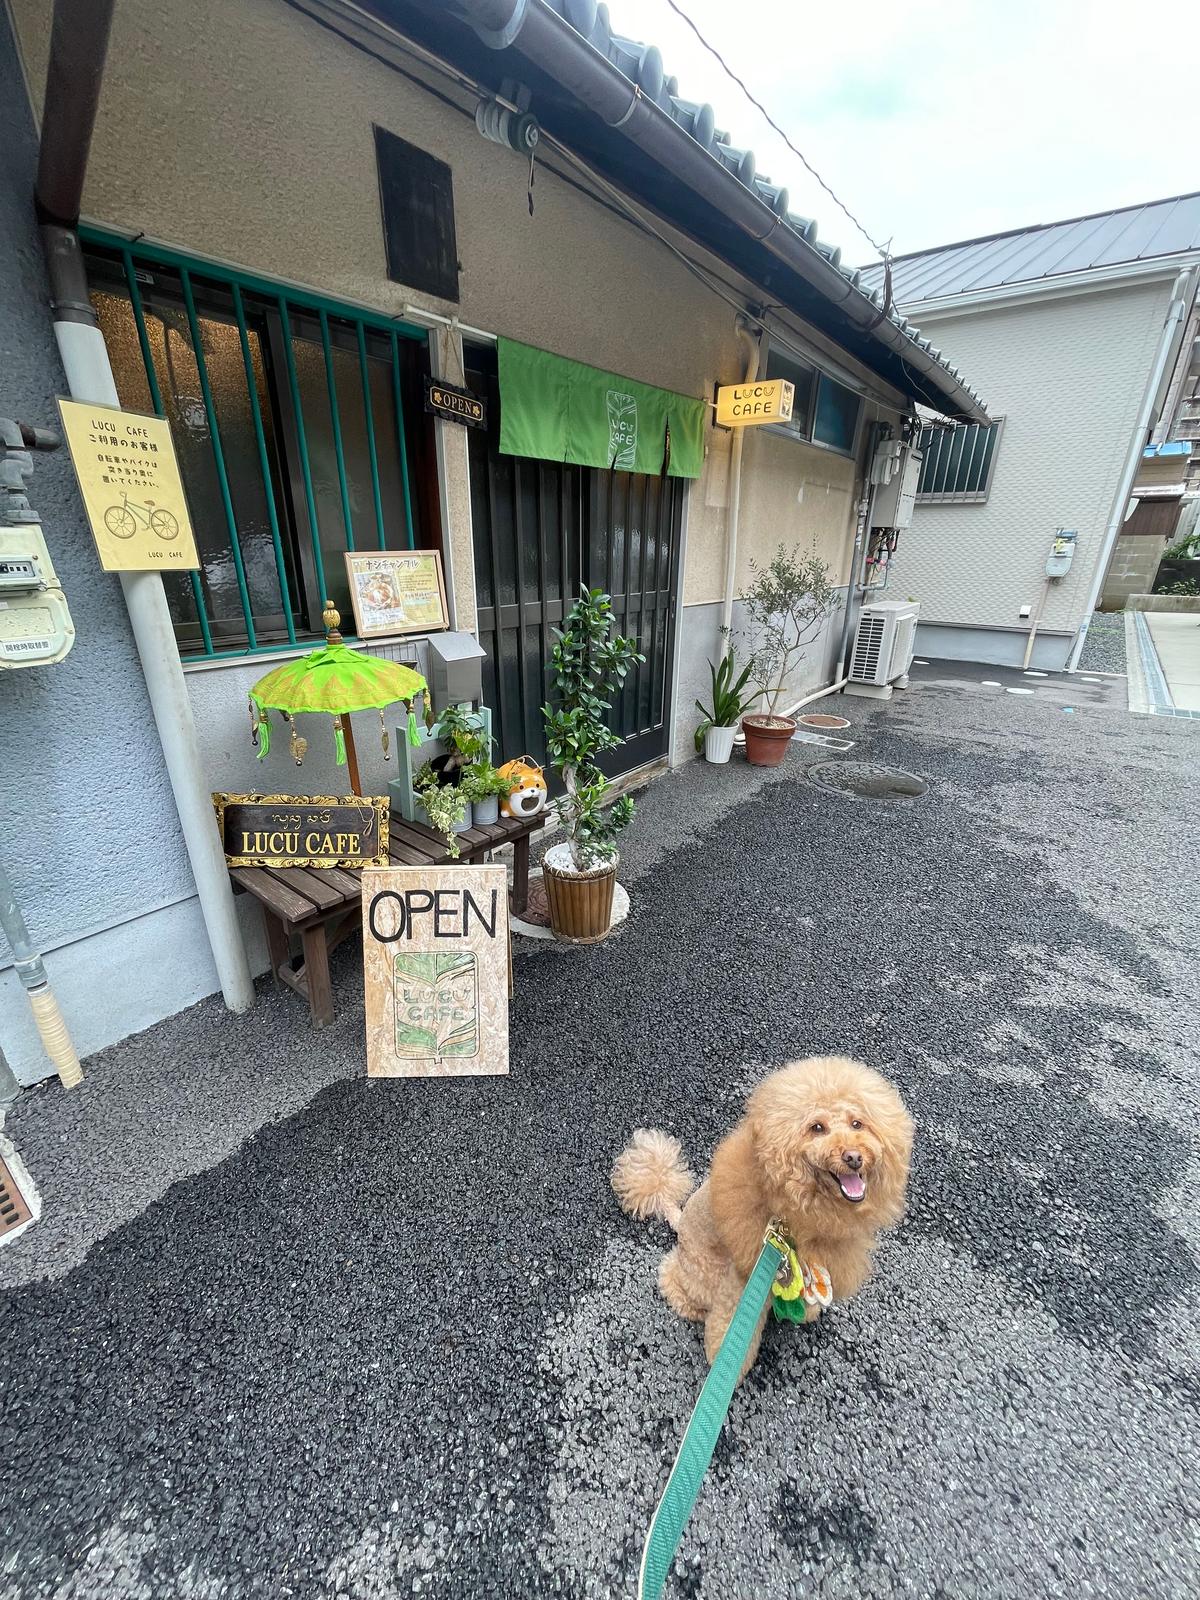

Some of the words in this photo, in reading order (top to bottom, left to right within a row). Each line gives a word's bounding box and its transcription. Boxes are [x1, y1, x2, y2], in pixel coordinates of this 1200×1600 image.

[733, 386, 776, 400] LUCU
[443, 394, 472, 414] OPEN
[732, 401, 772, 415] CAFE
[92, 420, 116, 432] LUCU
[126, 426, 149, 438] CAFE
[88, 434, 159, 452] ご利用のお客様
[148, 551, 163, 559] LUCU
[168, 551, 183, 559] CAFE
[242, 832, 300, 854] LUCU
[305, 832, 361, 855] CAFE
[369, 889, 498, 943] OPEN
[403, 989, 471, 1004] LUCU
[408, 1006, 465, 1021] CAFE
